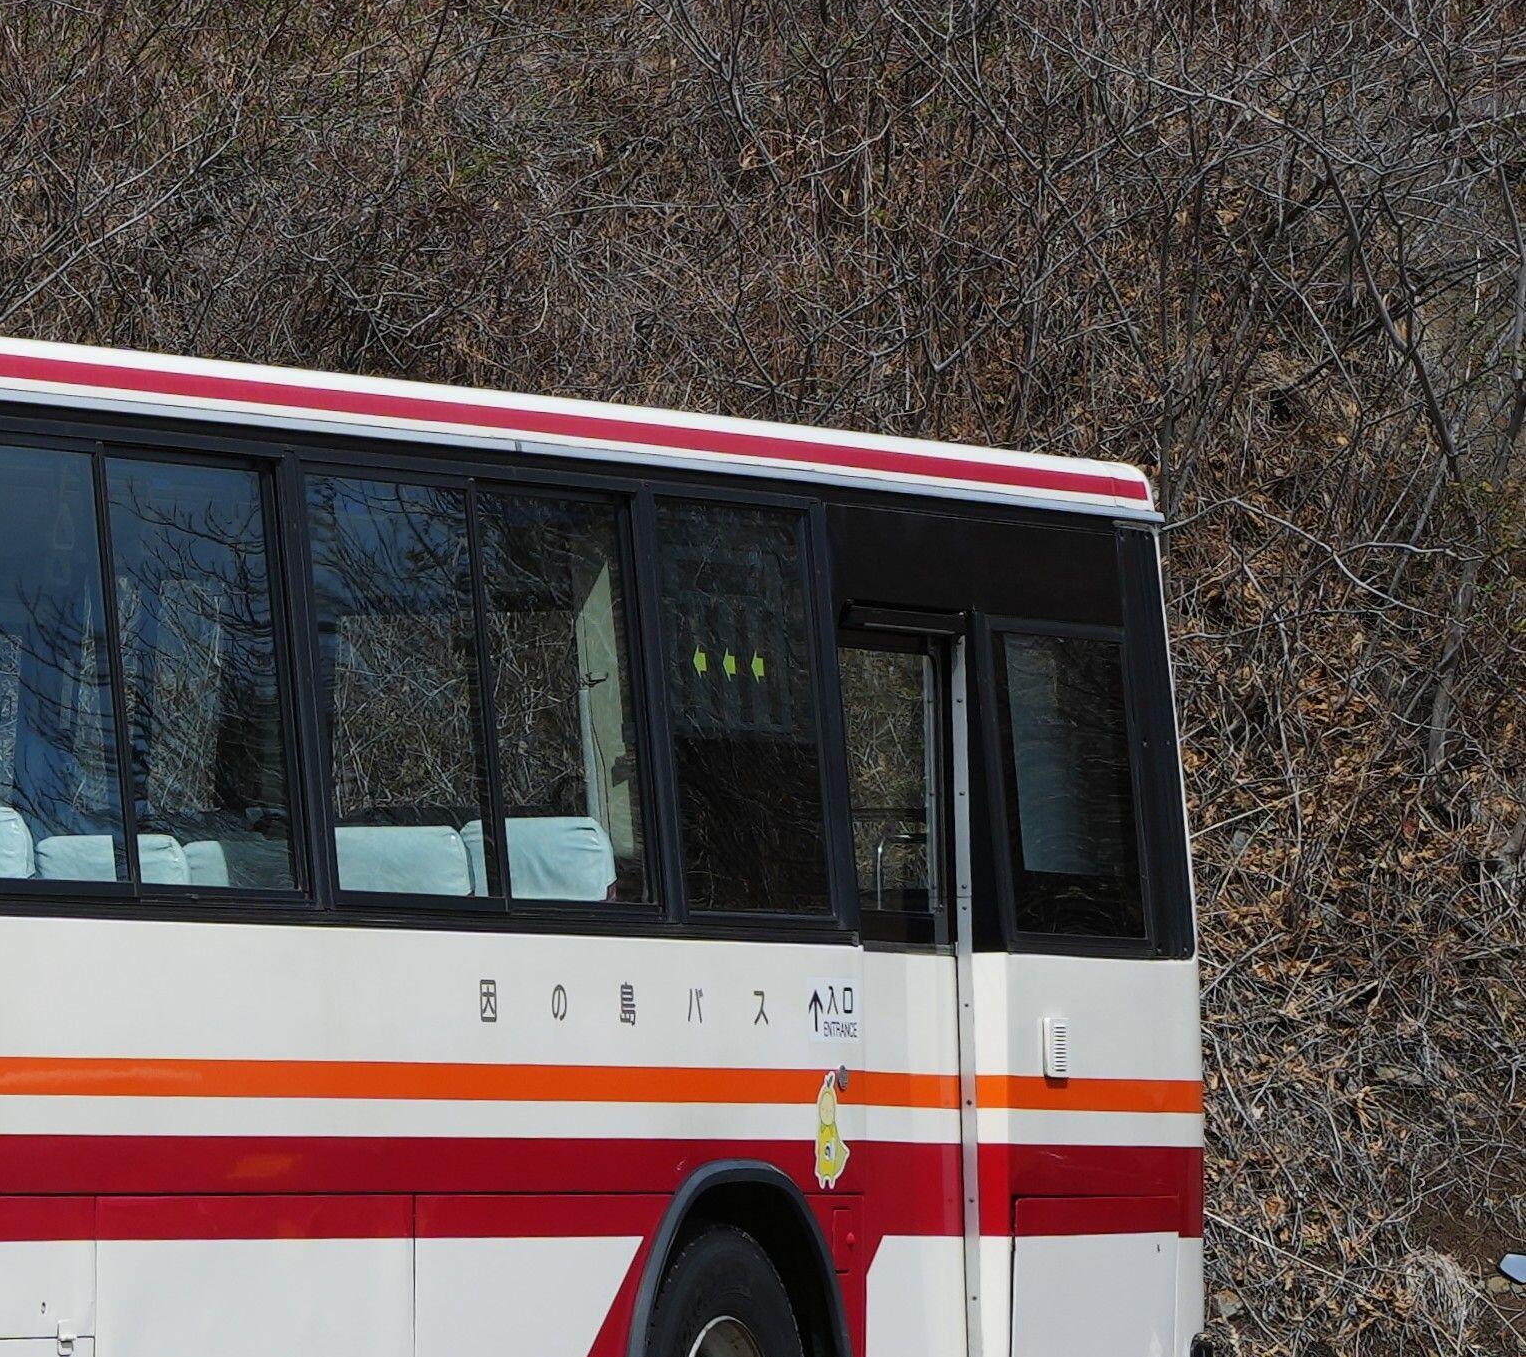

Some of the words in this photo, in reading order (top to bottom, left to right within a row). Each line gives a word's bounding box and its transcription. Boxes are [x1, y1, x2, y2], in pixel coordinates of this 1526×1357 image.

[479, 978, 770, 1026] 因の島バス
[827, 985, 853, 1015] 入口
[824, 1021, 857, 1038] ENTRANCE
